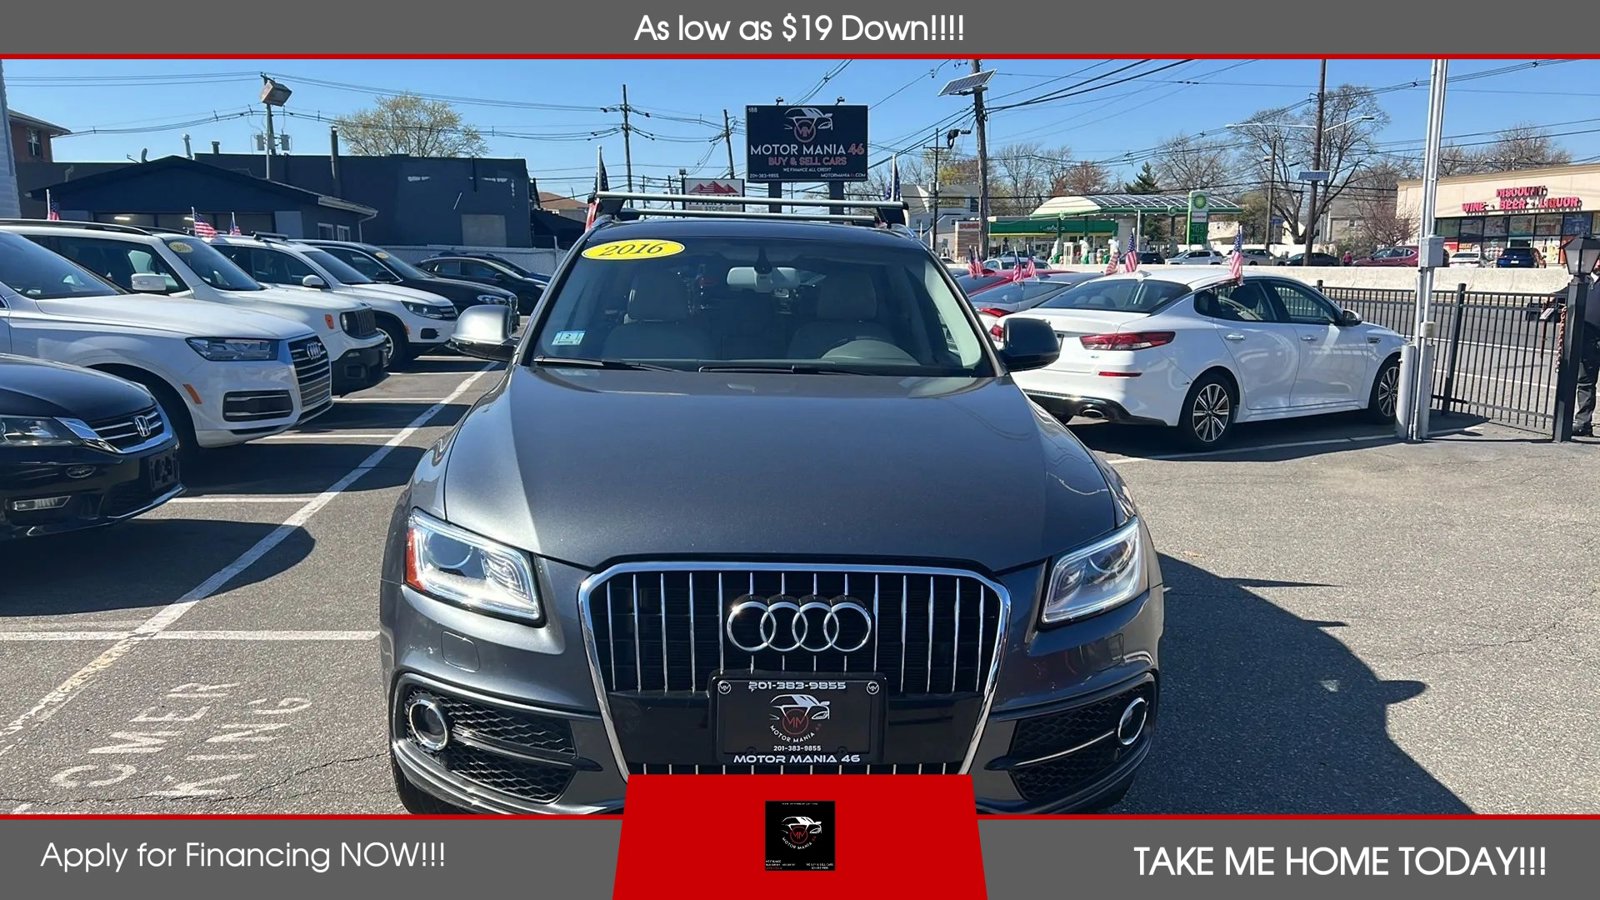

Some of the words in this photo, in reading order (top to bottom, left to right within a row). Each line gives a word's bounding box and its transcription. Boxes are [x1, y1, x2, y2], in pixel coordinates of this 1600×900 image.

[750, 144, 798, 155] MOTOR
[802, 144, 846, 155] MANIA
[848, 143, 865, 155] 46
[768, 157, 788, 166] BUY
[789, 157, 797, 166] &
[799, 157, 820, 166] SELL
[822, 157, 847, 166] CARS
[1461, 202, 1486, 212] WINE
[1499, 198, 1527, 210] BEER
[598, 242, 668, 257] 2016
[748, 680, 847, 691] 201-383-9855
[770, 725, 791, 742] MOTOR
[793, 732, 815, 742] MANIA
[733, 754, 786, 764] MOTOR
[789, 754, 838, 764] MANIA
[841, 754, 861, 763] 46
